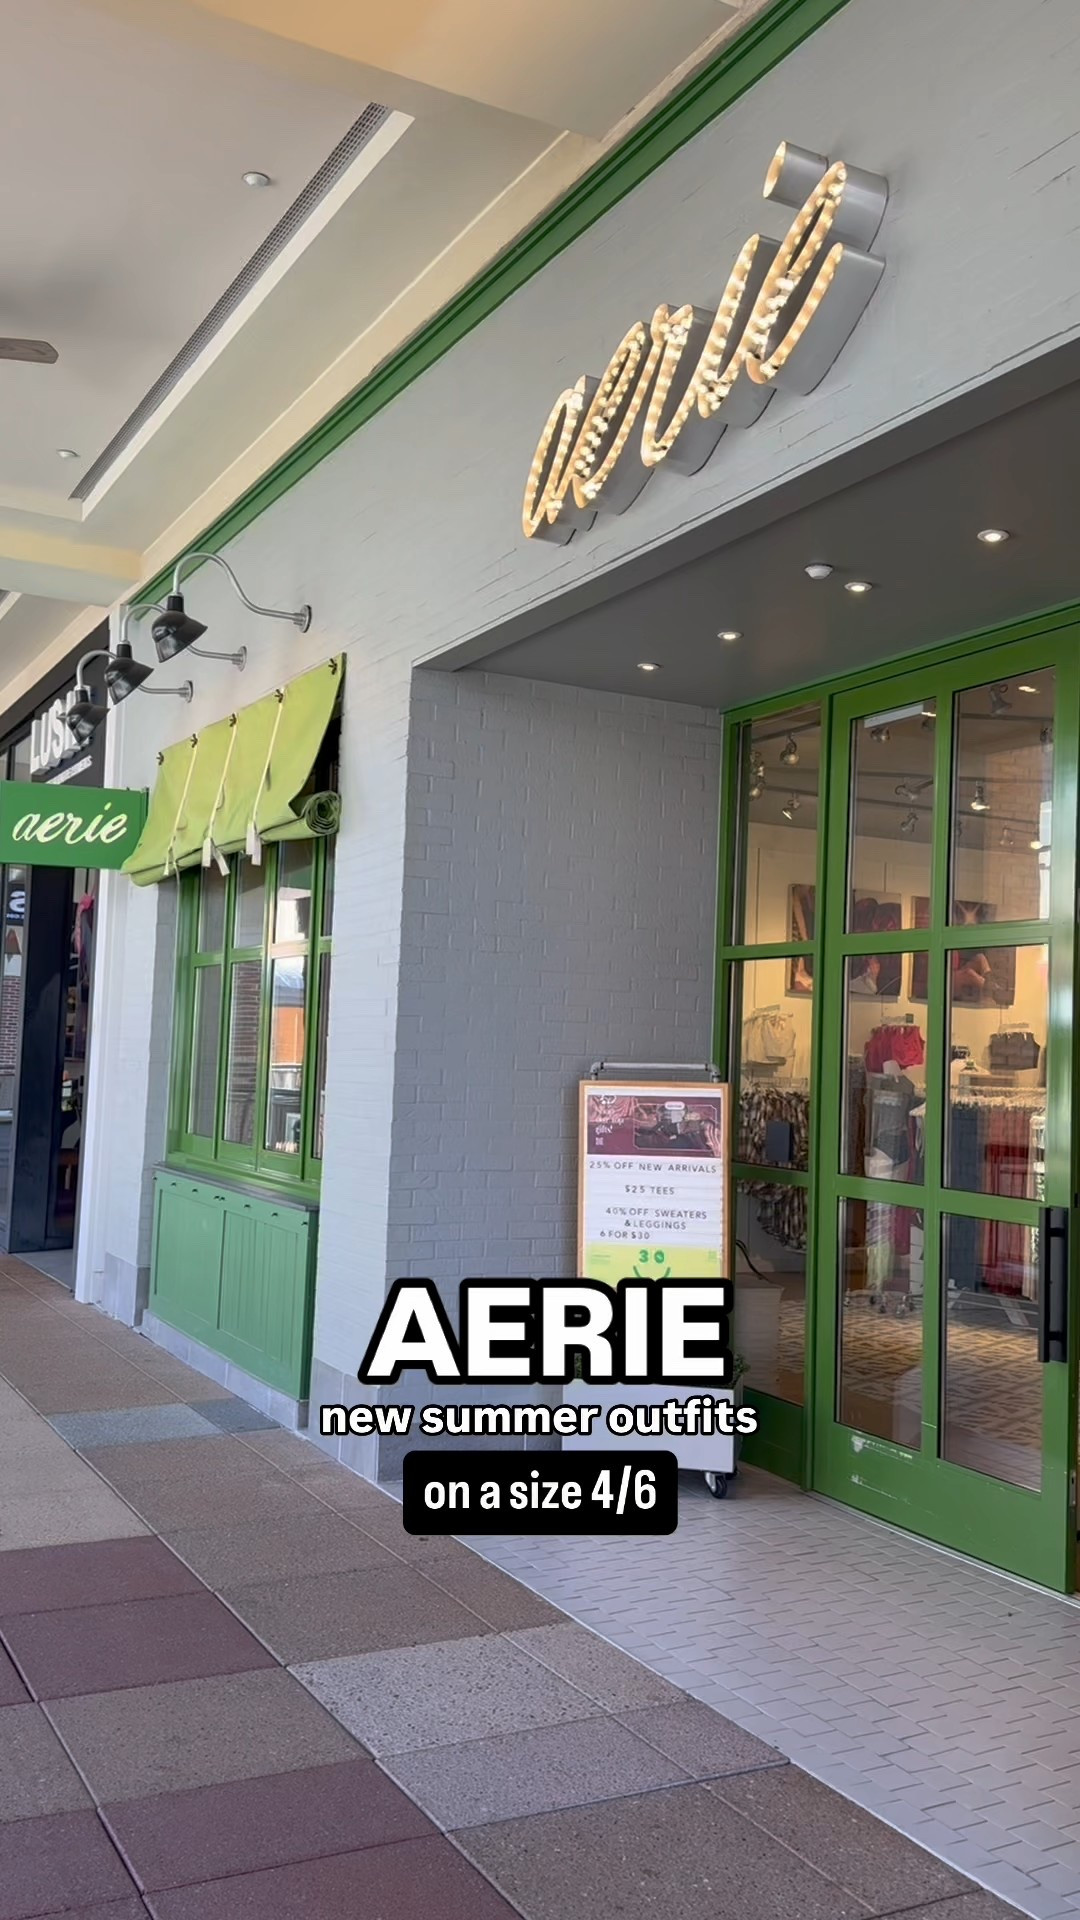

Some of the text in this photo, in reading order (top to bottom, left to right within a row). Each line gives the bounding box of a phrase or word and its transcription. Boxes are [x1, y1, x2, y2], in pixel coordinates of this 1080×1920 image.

[12, 802, 128, 845] aerie
[589, 1160, 717, 1174] 25% OFF NEW ARRIVALS
[624, 1184, 676, 1195] $25 TEES
[605, 1207, 708, 1220] 40% OFF SWEATERS
[633, 1220, 687, 1230] LEGGINGS
[608, 1231, 628, 1239] FOR
[631, 1231, 651, 1240] $30
